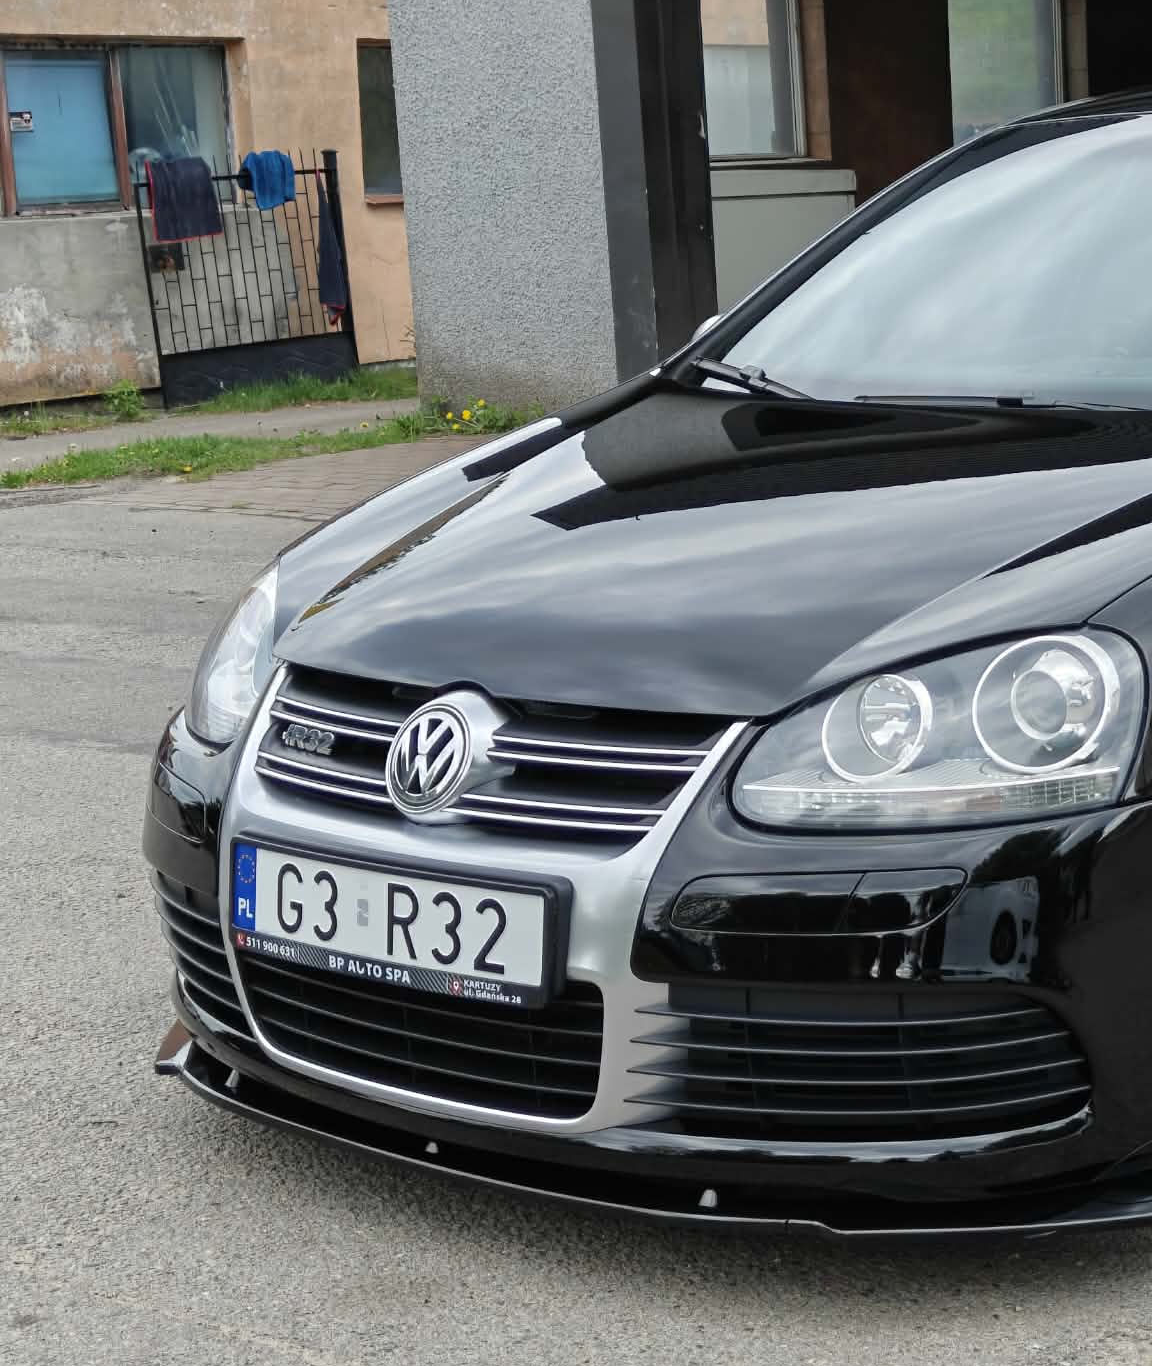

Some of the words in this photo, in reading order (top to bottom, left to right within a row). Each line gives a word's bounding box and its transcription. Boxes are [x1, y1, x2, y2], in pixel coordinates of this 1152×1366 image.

[238, 897, 254, 918] PL
[277, 863, 339, 941] G3
[387, 882, 507, 975] R32
[246, 937, 260, 949] 511
[263, 940, 278, 953] 900
[280, 945, 296, 958] 631
[328, 955, 344, 969] BP
[348, 960, 382, 977] AUTO
[385, 967, 410, 984] SPA
[463, 979, 501, 992] KARTUZY
